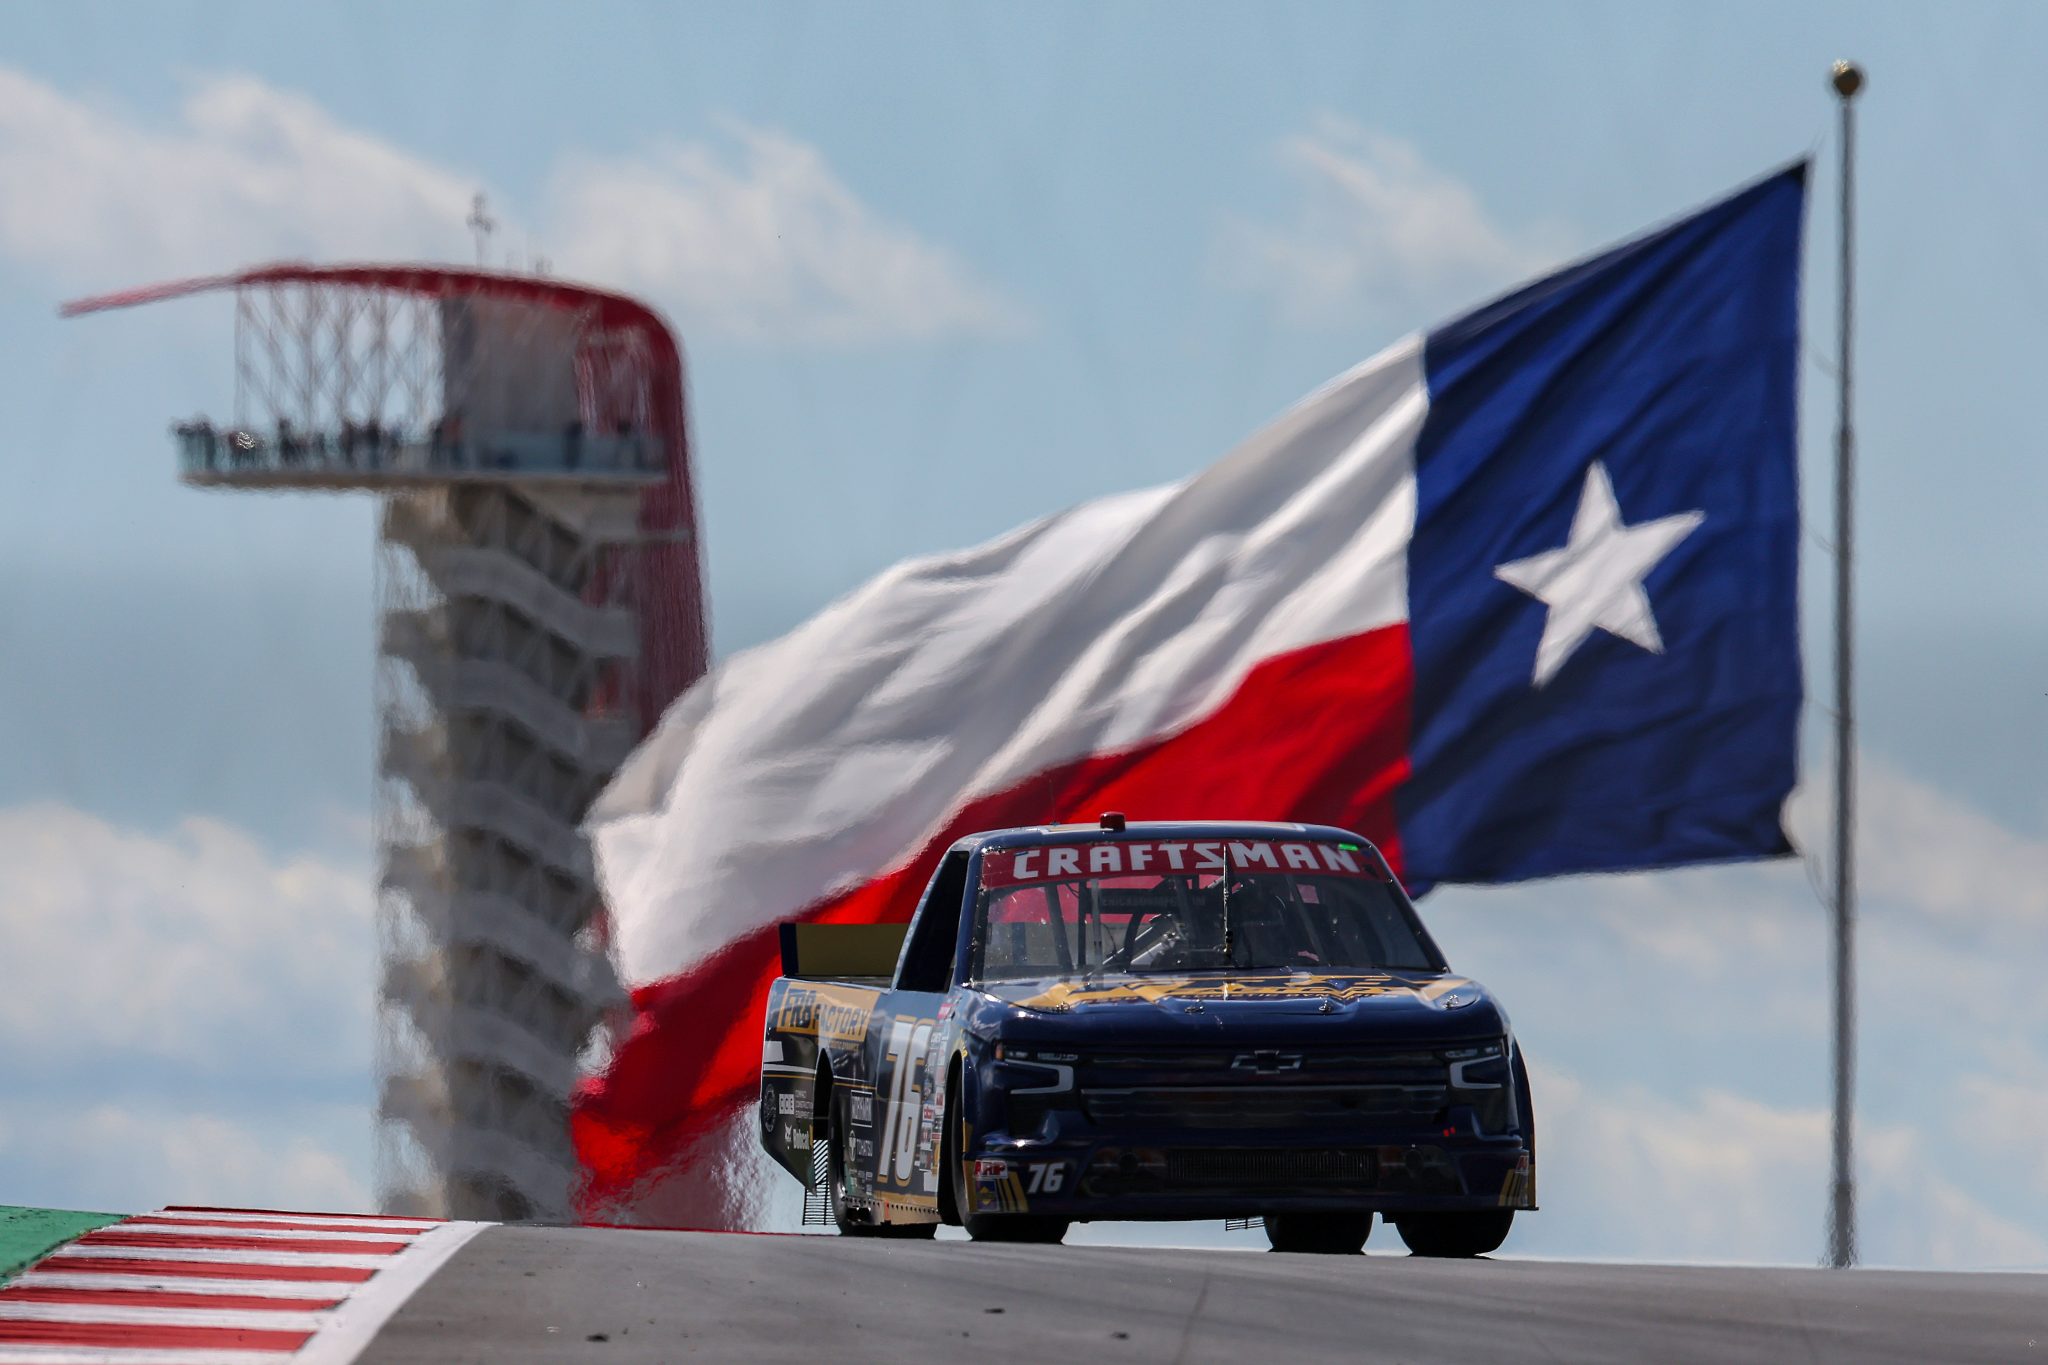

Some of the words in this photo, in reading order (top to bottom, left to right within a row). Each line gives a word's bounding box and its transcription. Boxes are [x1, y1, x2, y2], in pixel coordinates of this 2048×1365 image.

[1013, 841, 1361, 880] CRAFTSMAN
[877, 1014, 935, 1186] 76
[1027, 1162, 1065, 1194] 76
